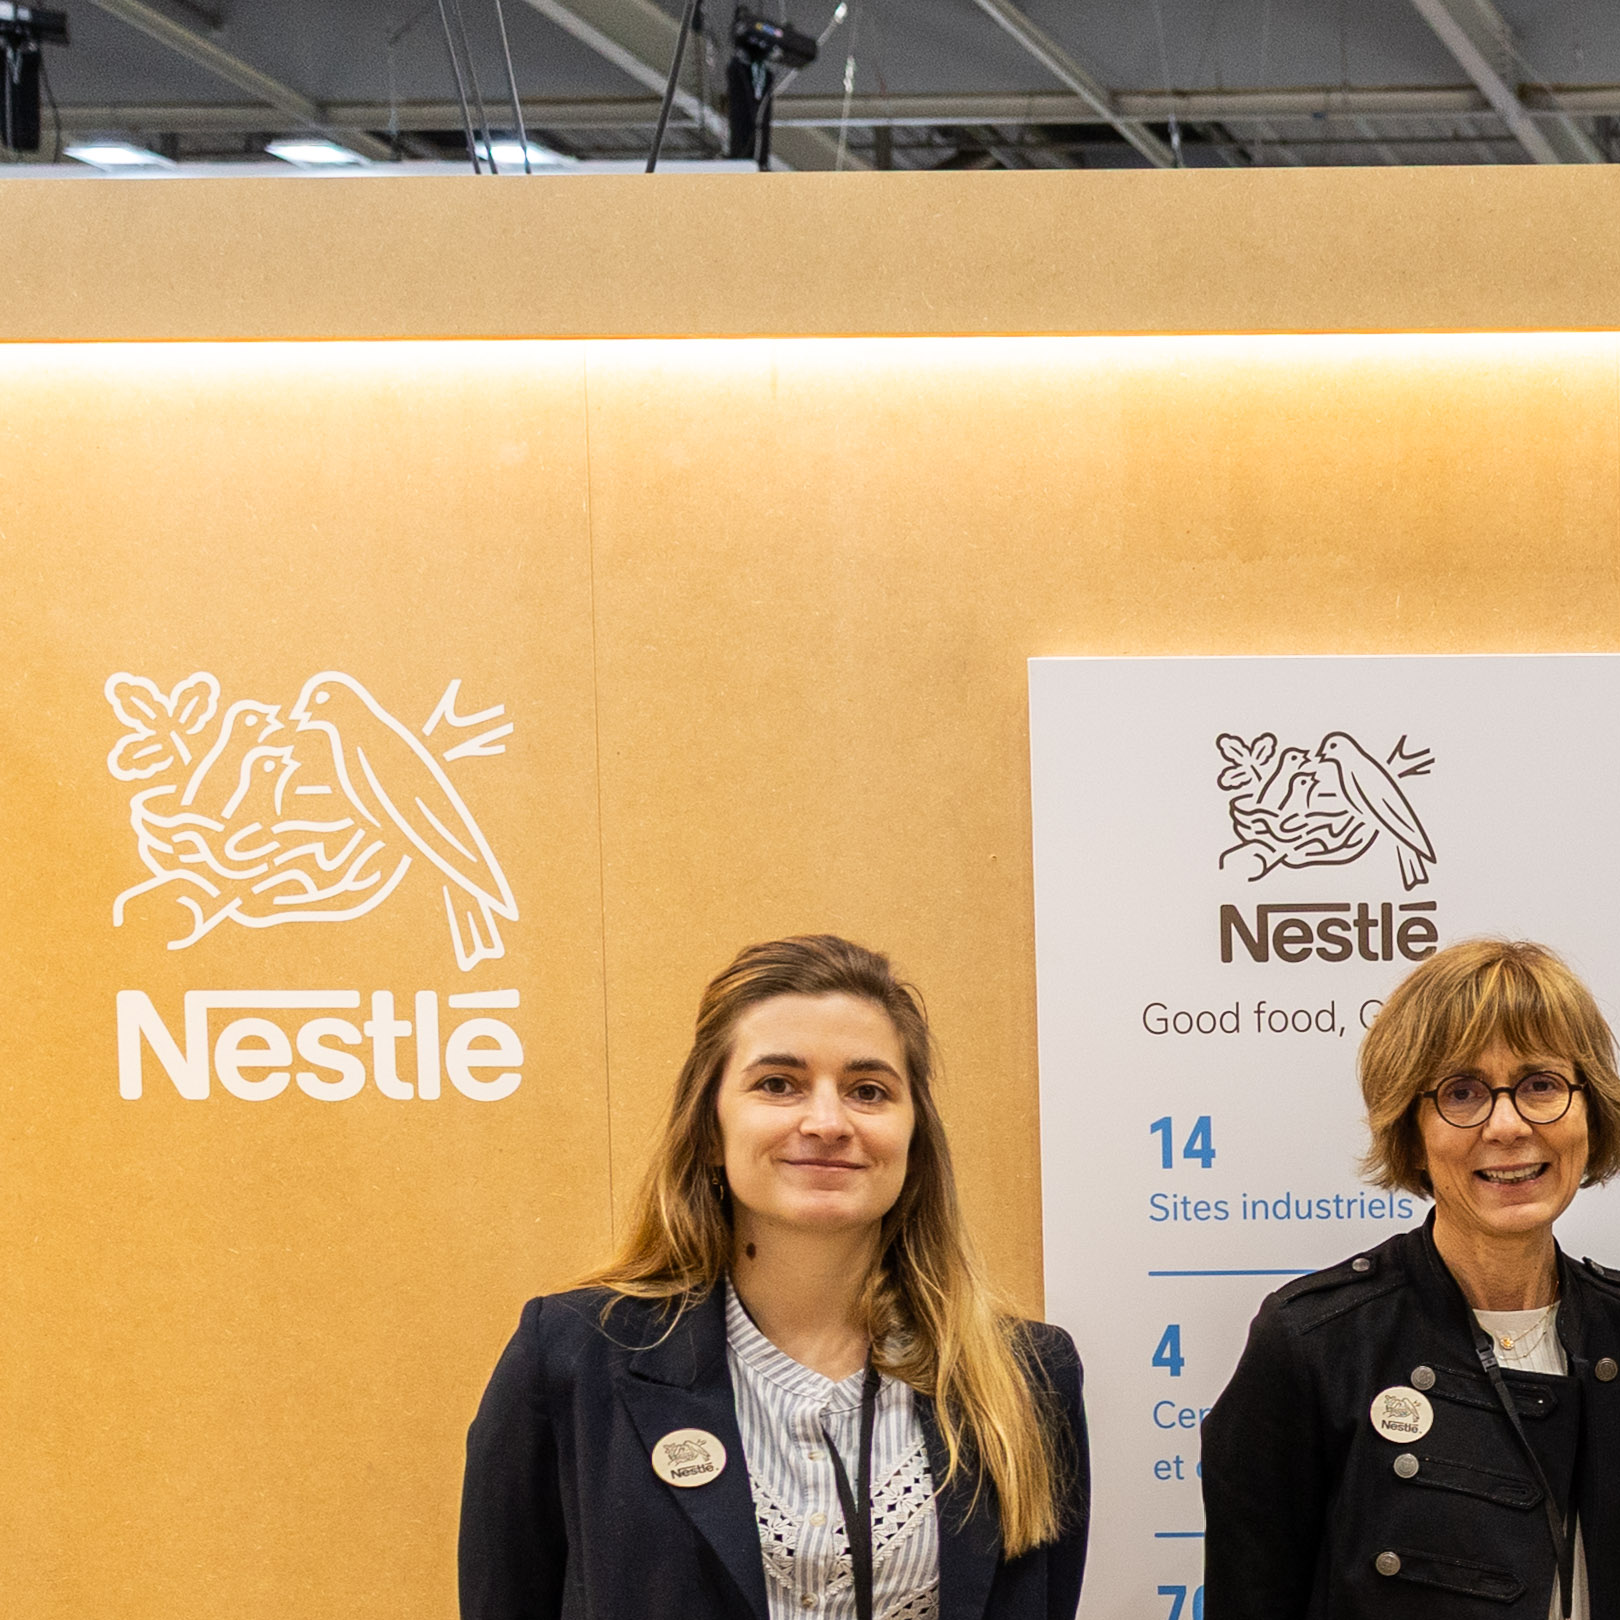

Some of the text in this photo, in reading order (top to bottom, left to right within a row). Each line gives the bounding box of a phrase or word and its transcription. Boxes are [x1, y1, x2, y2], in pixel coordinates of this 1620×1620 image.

[1219, 901, 1439, 963] Nestlé
[116, 988, 524, 1102] Nestlé
[1143, 1001, 1240, 1035] Good
[1253, 1000, 1346, 1038] food,
[1150, 1115, 1216, 1169] 14
[1149, 1190, 1414, 1222] Sites industriels
[1152, 1324, 1185, 1377] 4
[1154, 1455, 1184, 1480] et
